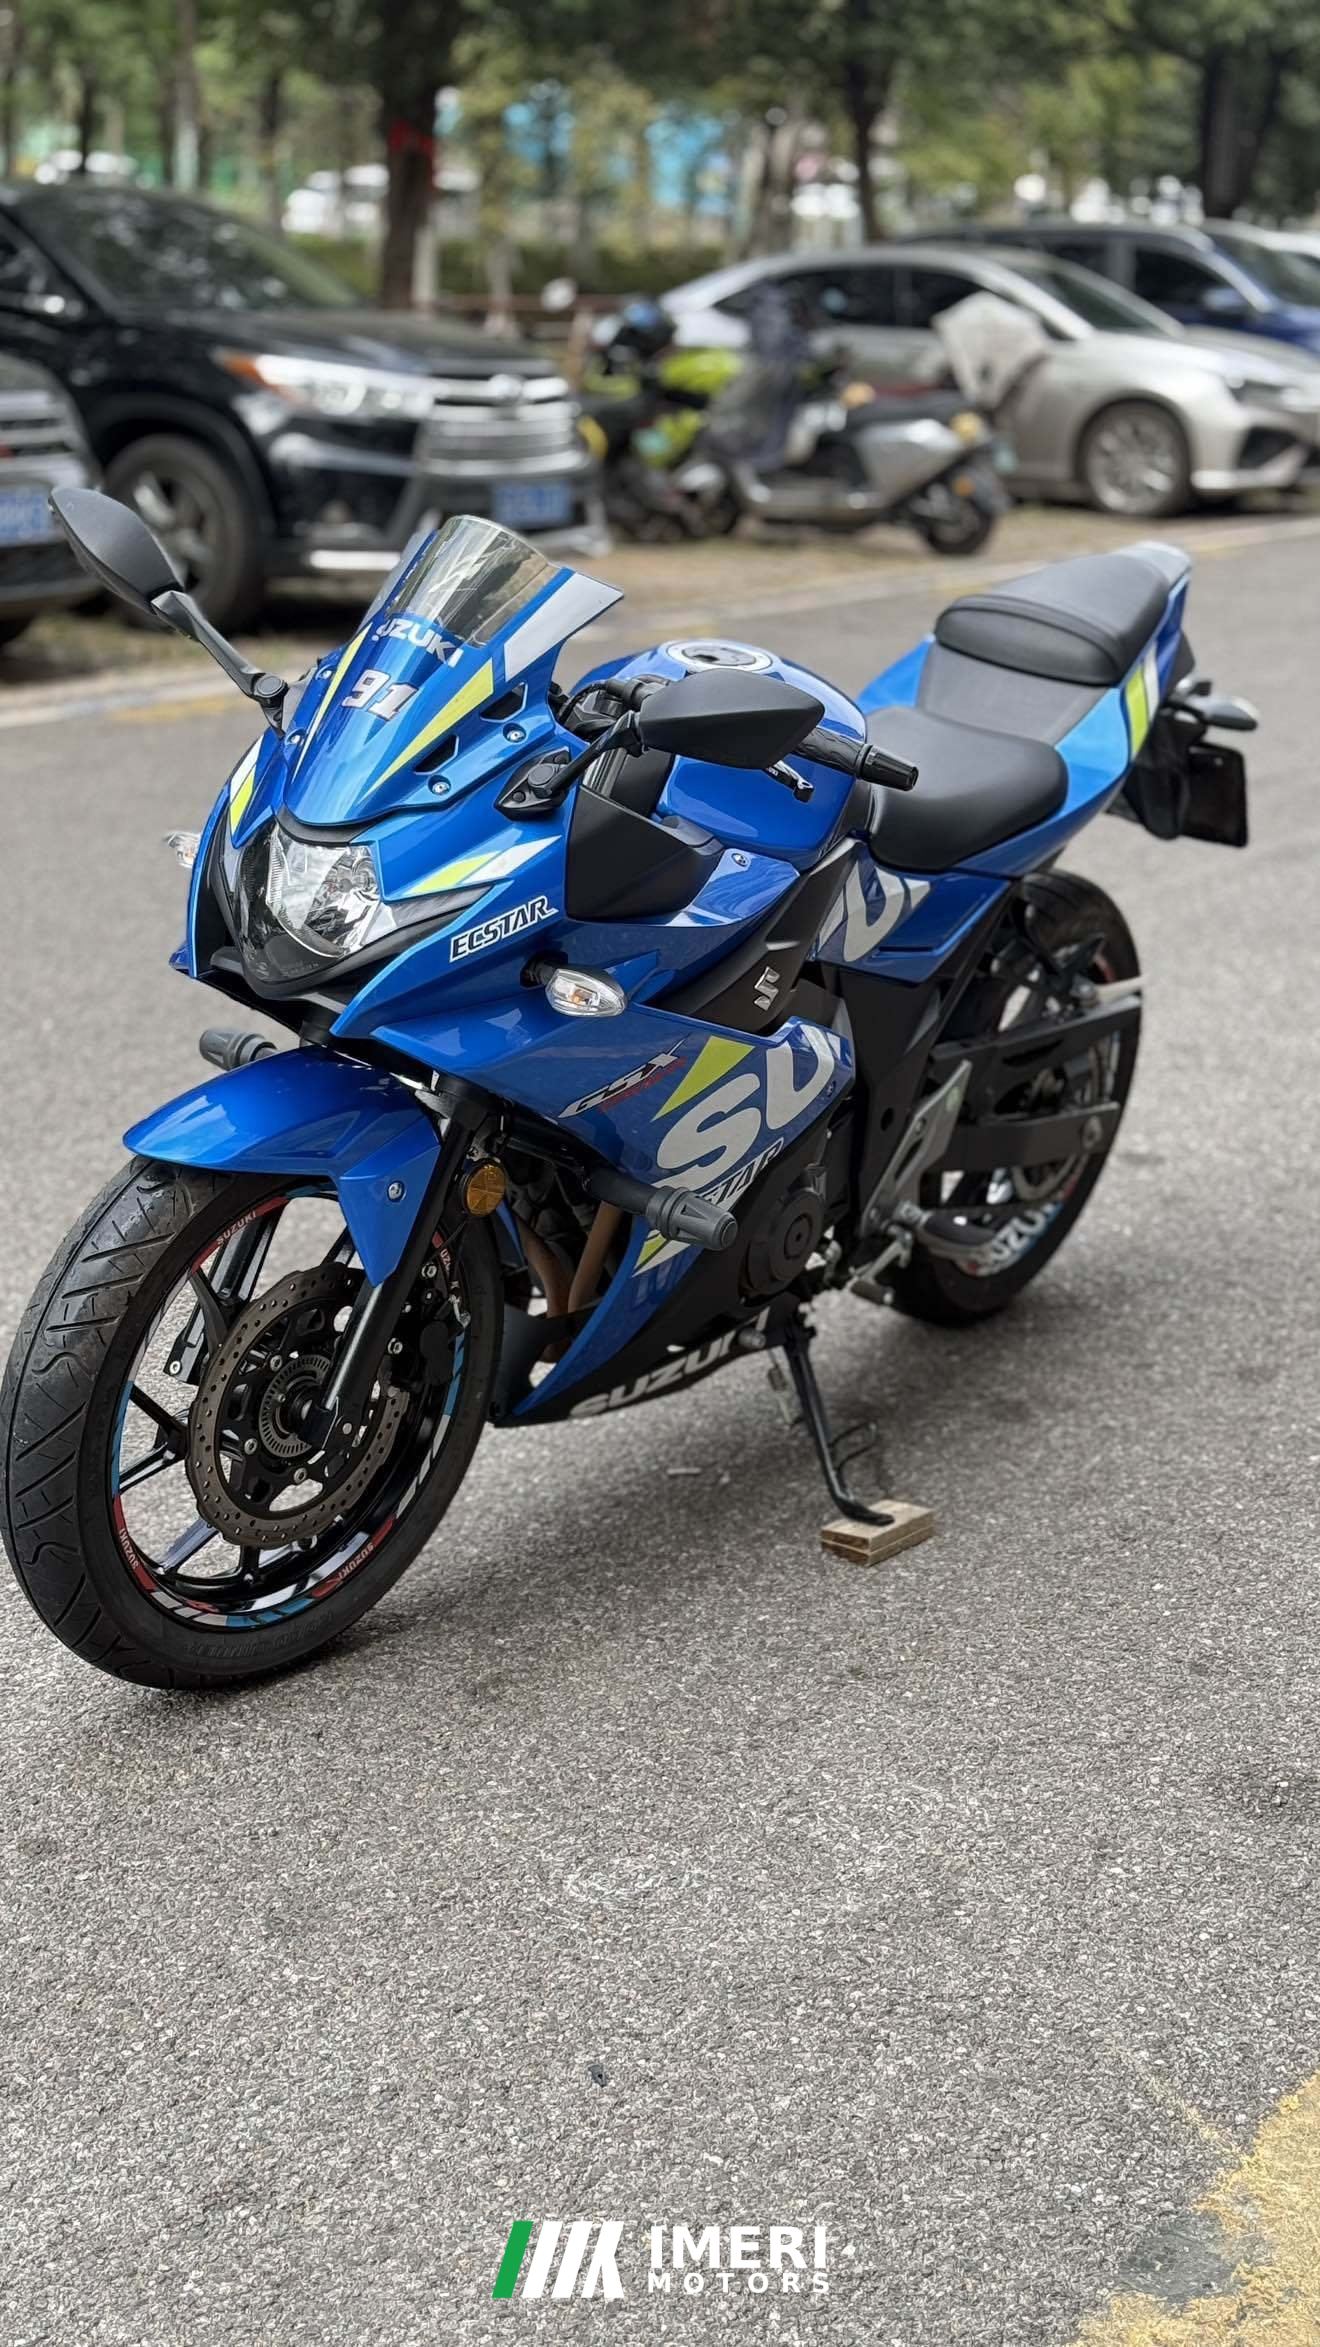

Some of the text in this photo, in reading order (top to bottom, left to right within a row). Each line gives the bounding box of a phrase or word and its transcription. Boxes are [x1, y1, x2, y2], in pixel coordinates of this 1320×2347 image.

[371, 618, 464, 668] UZUKI
[341, 668, 418, 721] 91
[449, 895, 559, 963] ECSTAR
[217, 1211, 257, 1248] SUZUKI
[119, 1528, 139, 1570] SUZUKI
[339, 1542, 376, 1579] SUZUKI
